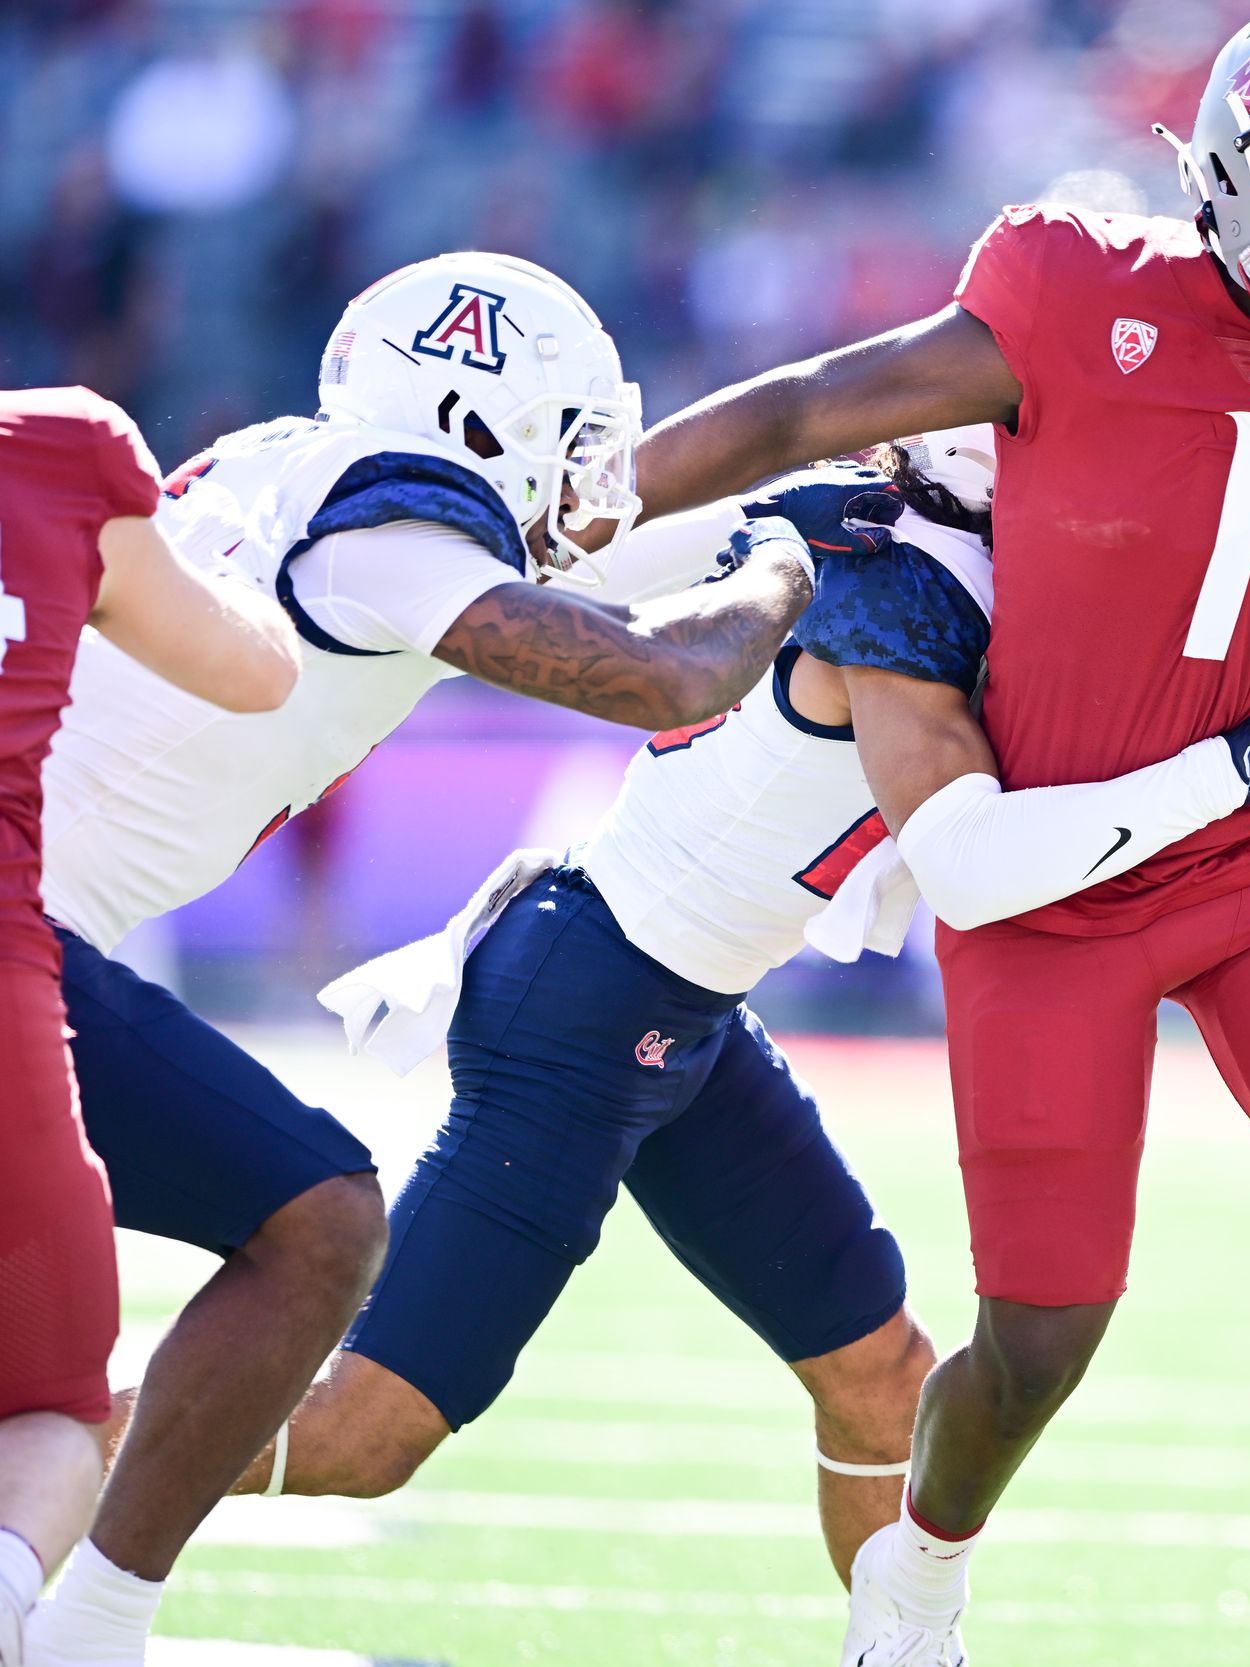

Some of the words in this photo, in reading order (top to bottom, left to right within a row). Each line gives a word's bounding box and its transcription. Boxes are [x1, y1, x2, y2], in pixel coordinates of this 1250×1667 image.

[412, 283, 506, 375] A
[1114, 321, 1157, 356] PAC
[1119, 341, 1141, 363] 12
